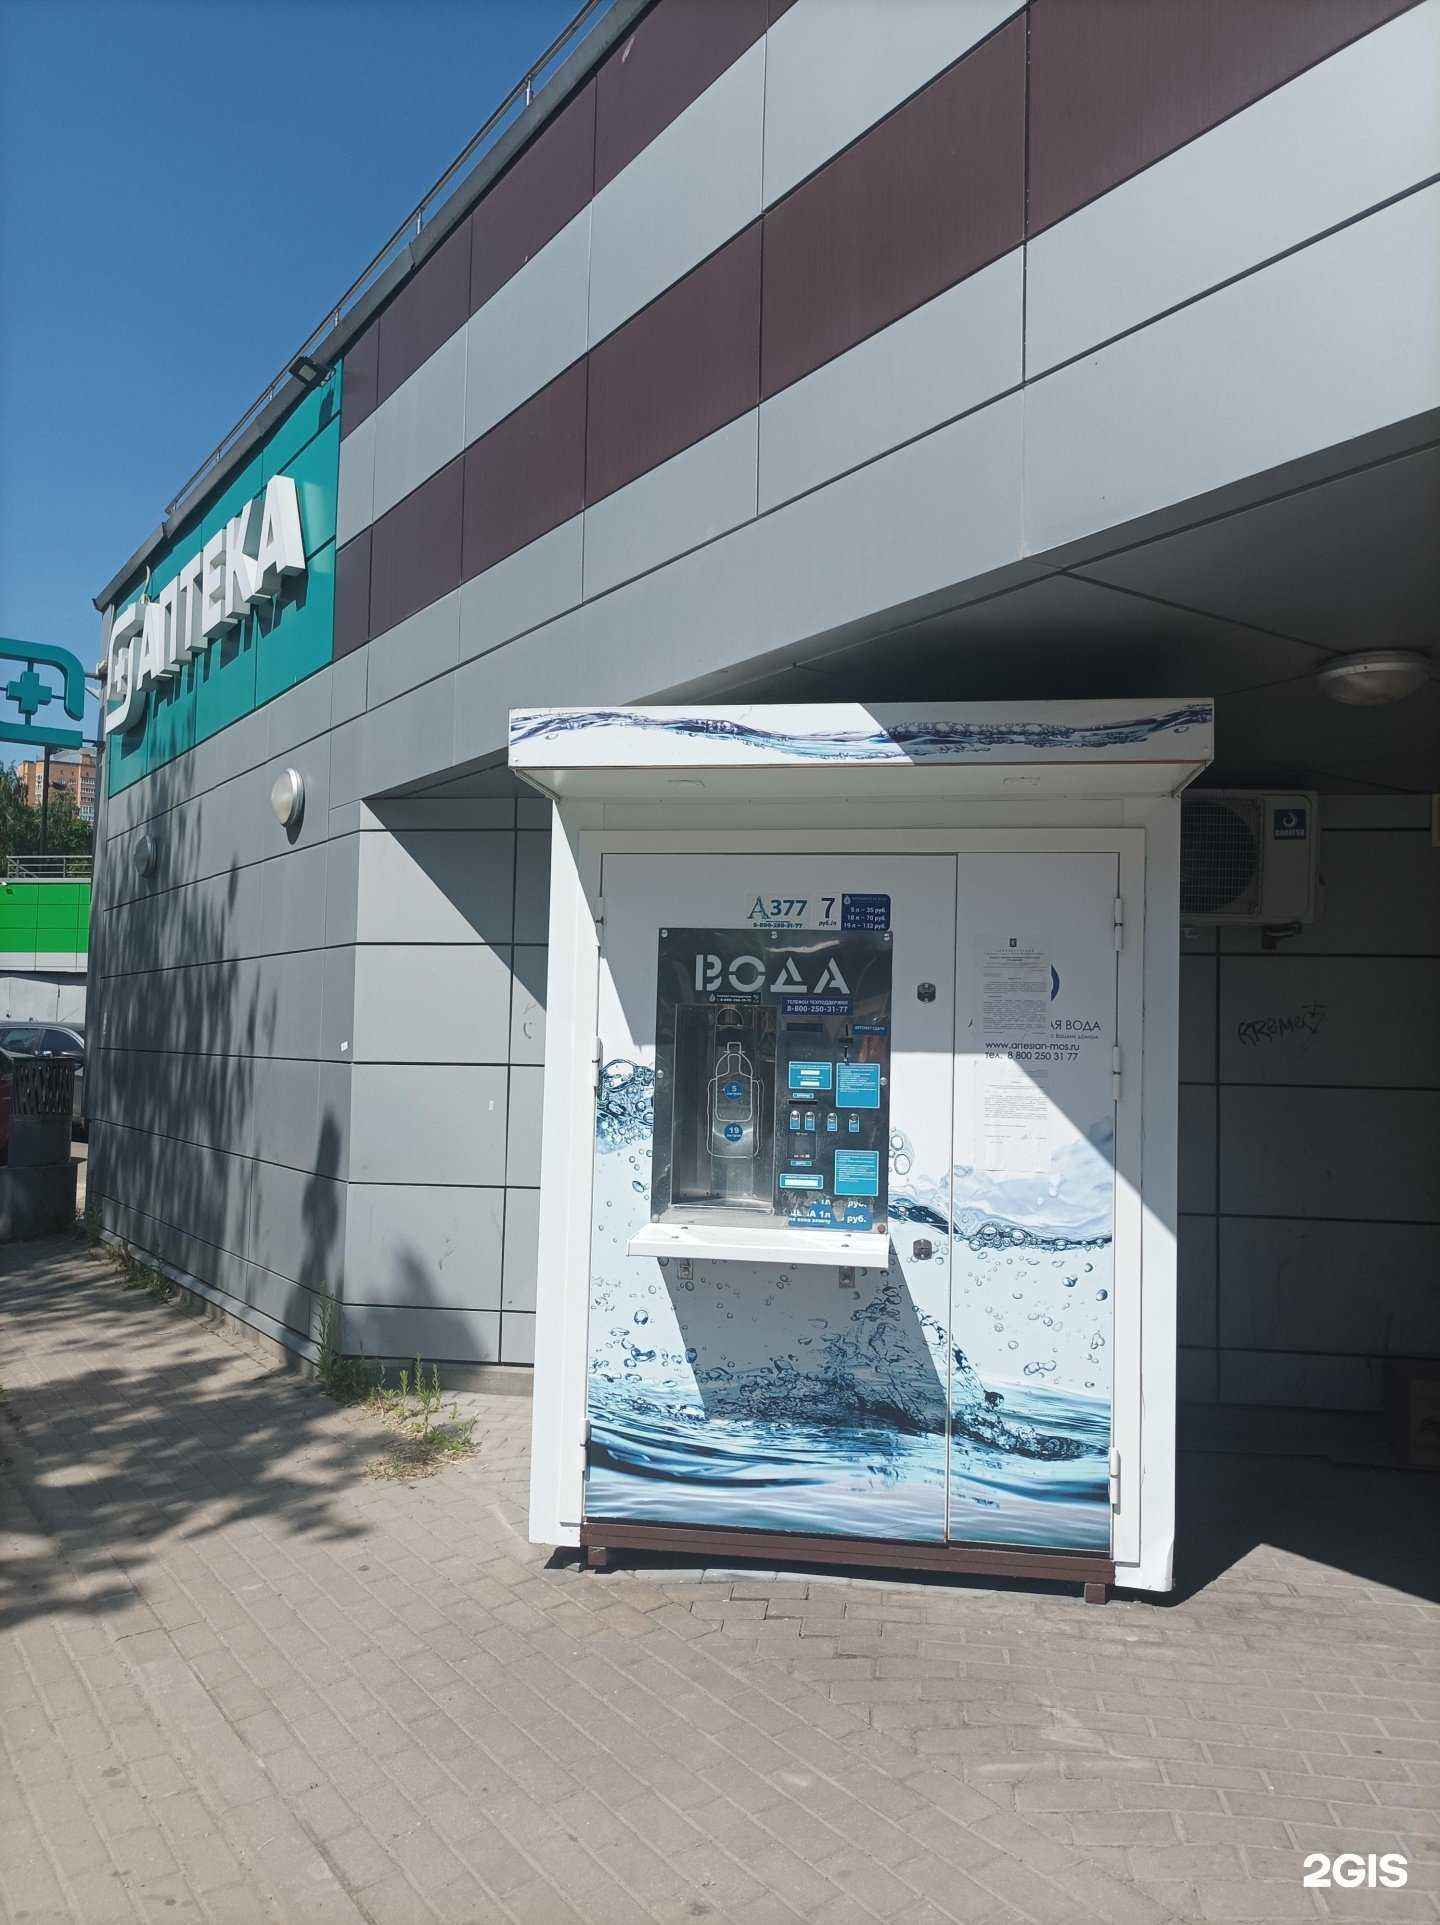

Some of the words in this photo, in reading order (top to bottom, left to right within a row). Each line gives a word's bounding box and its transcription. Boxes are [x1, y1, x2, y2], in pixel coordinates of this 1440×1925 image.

[136, 475, 306, 691] АПТЕКА
[821, 897, 836, 919] 7
[695, 954, 850, 994] ВОДА
[786, 1005, 848, 1013] 8-800-250-31-77
[1065, 1019, 1102, 1031] ВОДА
[1007, 1052, 1013, 1060] 8
[1015, 1052, 1032, 1060] 800
[1034, 1052, 1052, 1060] 250
[1053, 1052, 1064, 1061] 31
[1066, 1053, 1079, 1061] 77
[846, 1214, 866, 1224] руб.
